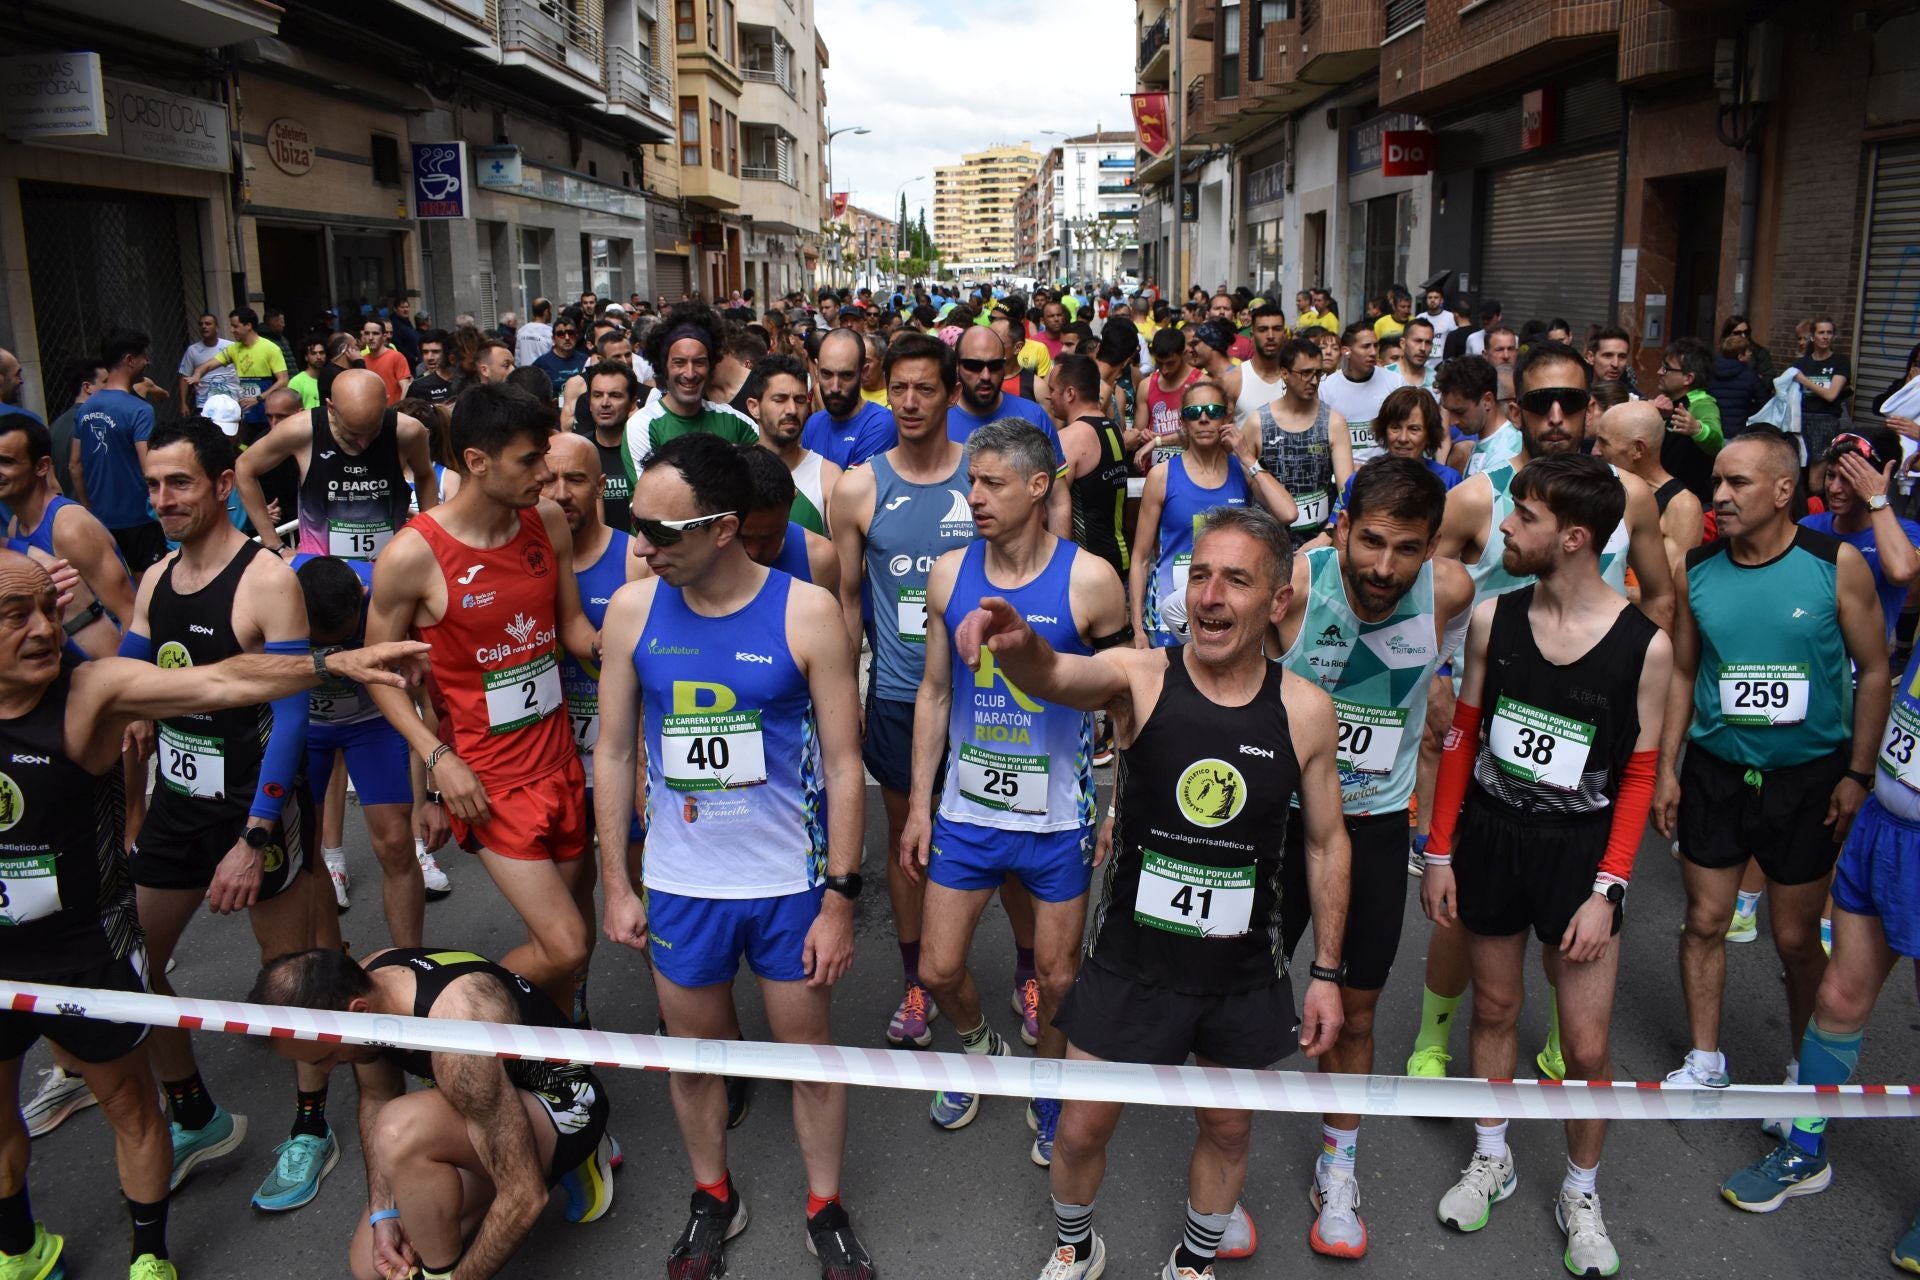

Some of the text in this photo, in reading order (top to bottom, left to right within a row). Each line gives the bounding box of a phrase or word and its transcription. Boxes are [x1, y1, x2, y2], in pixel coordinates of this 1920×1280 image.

[18, 60, 74, 77] TOMÁS
[122, 92, 215, 138] CRISTÓBAL
[275, 142, 310, 167] Ibiza
[328, 480, 388, 491] O BARCO
[1303, 502, 1320, 520] 17
[350, 534, 375, 552] 15
[952, 529, 974, 538] Rioja
[476, 644, 511, 663] Caja
[512, 645, 526, 654] rural
[1321, 659, 1330, 667] La
[503, 664, 531, 677] CARRERA
[531, 655, 550, 669] POPULAR
[521, 680, 538, 709] 2
[975, 694, 1006, 707] CLUB
[1734, 681, 1789, 708] 259
[676, 717, 709, 725] CARRERA
[711, 714, 746, 723] POPULAR
[975, 710, 1032, 727] MARATÓN
[1332, 702, 1365, 714] CARRERA
[1366, 708, 1397, 717] POPULAR
[1517, 706, 1548, 721] CARRERA
[1549, 716, 1582, 732] POPULAR
[1498, 708, 1527, 724] CALAHORRA
[1547, 724, 1554, 732] DE
[1554, 726, 1562, 735] LA
[185, 736, 212, 746] POPULAR
[976, 725, 1030, 745] RIOJA
[1338, 722, 1373, 755] 20
[1886, 726, 1916, 764] 23
[686, 736, 729, 770] 40
[978, 749, 1006, 762] CARRERA
[1513, 727, 1556, 765] 38
[170, 748, 197, 780] 26
[983, 769, 1018, 797] 25
[1186, 768, 1210, 785] ATLETICO
[1150, 827, 1254, 851] www.calagurrisatletico.es
[0, 860, 39, 869] POPULAR
[1145, 862, 1180, 880] CALAHORRA
[1181, 874, 1204, 885] CIUDAD
[1205, 878, 1212, 886] DE
[1223, 879, 1251, 887] VERDURA
[1156, 857, 1243, 878] XV CARRERA POPULAR
[1170, 885, 1213, 920] 41
